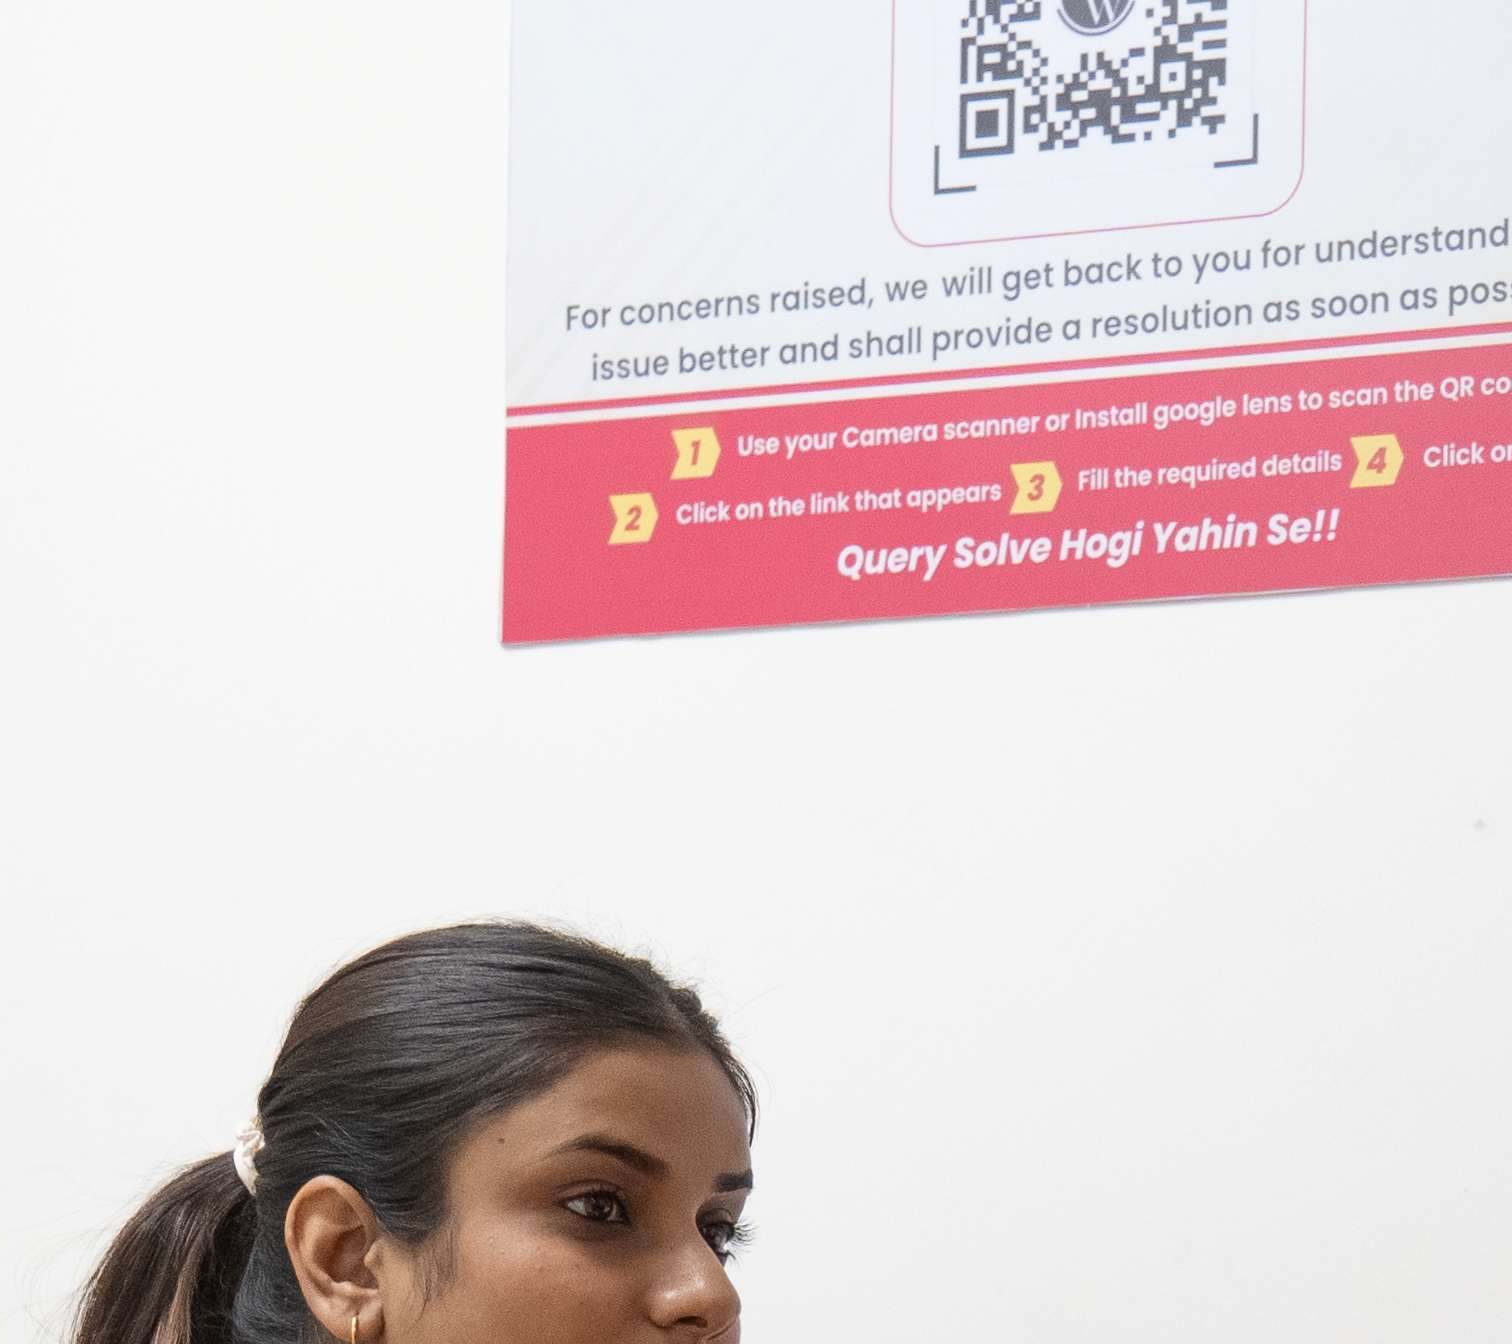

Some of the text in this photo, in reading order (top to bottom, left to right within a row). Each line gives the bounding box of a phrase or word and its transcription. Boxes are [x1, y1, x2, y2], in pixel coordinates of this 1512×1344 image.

[567, 305, 611, 331] For
[620, 294, 760, 326] concerns
[771, 277, 873, 312] raised,
[885, 280, 928, 302] we
[942, 266, 992, 297] will
[1002, 263, 1053, 301] get
[1064, 253, 1142, 286] back
[1152, 253, 1182, 278] to
[1192, 249, 1251, 284] you
[1262, 239, 1305, 268] for
[593, 353, 669, 381] issue
[679, 344, 770, 373] better
[779, 334, 838, 364] and
[849, 326, 921, 358] shall
[933, 317, 1052, 361] provide
[1062, 319, 1080, 340] a
[1092, 300, 1252, 338] resolution
[1263, 300, 1300, 323] as
[1311, 292, 1389, 318] soon
[1400, 288, 1437, 310] as
[691, 440, 701, 465] 1
[738, 435, 780, 456] Use
[785, 432, 837, 459] your
[842, 424, 938, 448] Camera
[944, 416, 1040, 440] scanner
[1045, 413, 1070, 432] or
[1075, 402, 1147, 429] Install
[1153, 396, 1237, 430] google
[1243, 394, 1292, 415] lens
[1298, 390, 1323, 410] to
[1329, 387, 1388, 408] scan
[1394, 380, 1434, 402] the
[1440, 376, 1474, 401] QR
[624, 505, 642, 531] 2
[676, 501, 730, 524] Click
[735, 502, 763, 520] on
[768, 496, 805, 517] the
[810, 492, 849, 514] link
[855, 489, 901, 511] that
[906, 484, 1002, 512] appears
[1027, 474, 1045, 501] 3
[1078, 468, 1108, 491] Fill
[1114, 466, 1152, 488] the
[1158, 456, 1256, 488] required
[1262, 450, 1342, 476] details
[1367, 447, 1387, 473] 4
[1423, 442, 1484, 468] Click
[838, 509, 1340, 581] Query Solve Hogi Yahin Se!!
